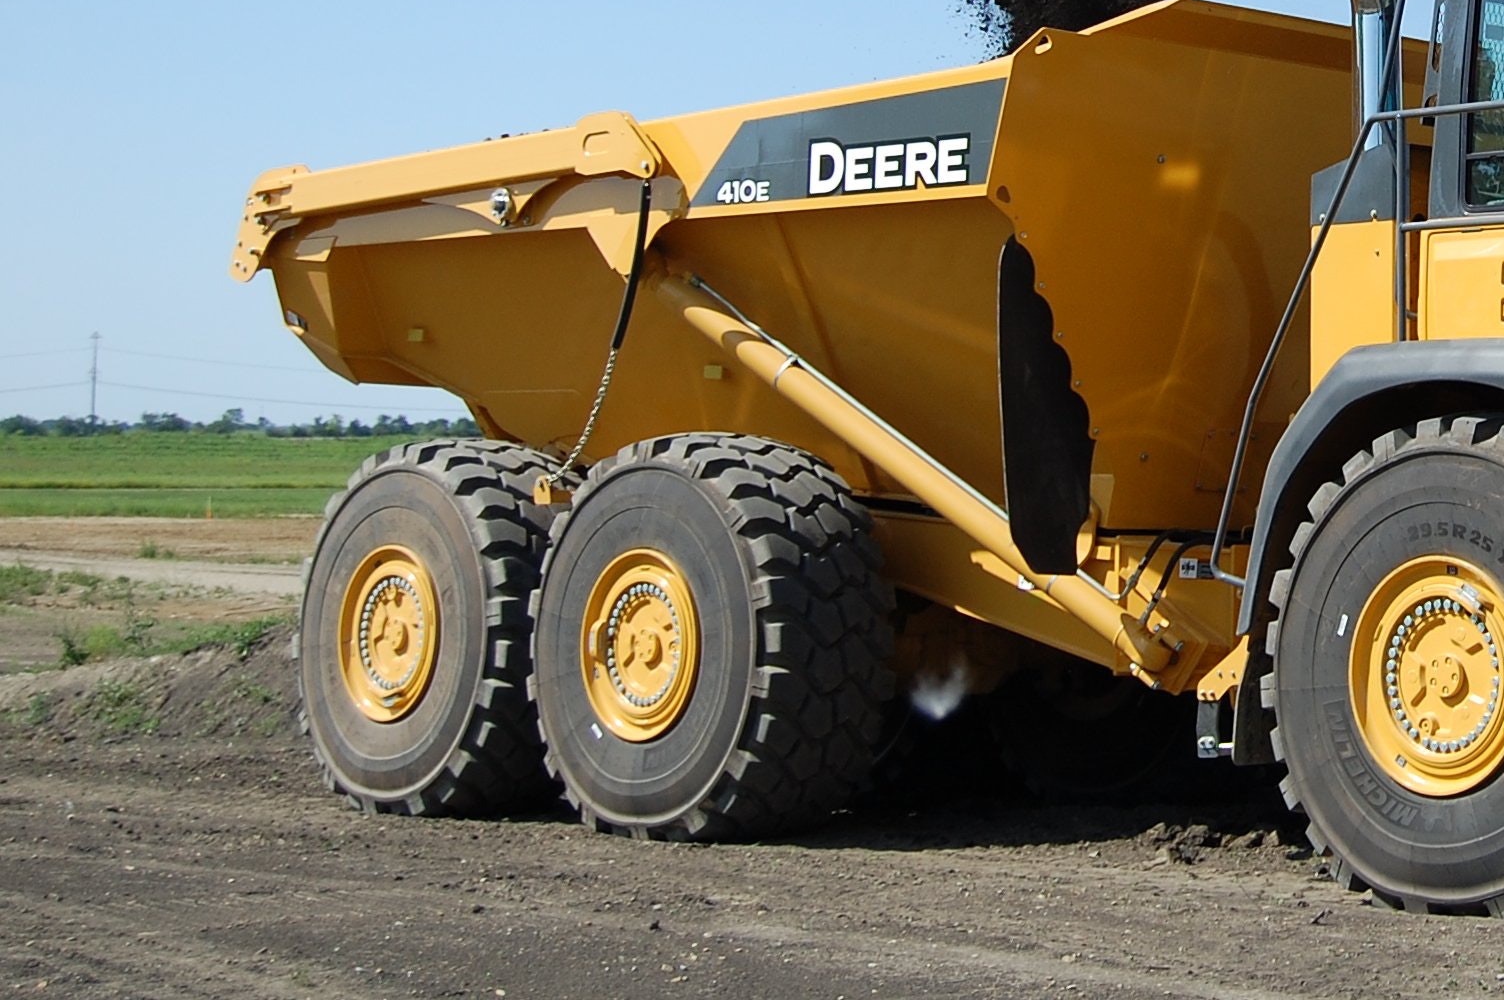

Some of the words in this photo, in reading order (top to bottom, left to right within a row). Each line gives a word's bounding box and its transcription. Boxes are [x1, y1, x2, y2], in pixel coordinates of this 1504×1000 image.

[716, 179, 771, 204] 410E
[808, 137, 969, 195] DEERE
[1325, 706, 1418, 828] MICHELIN
